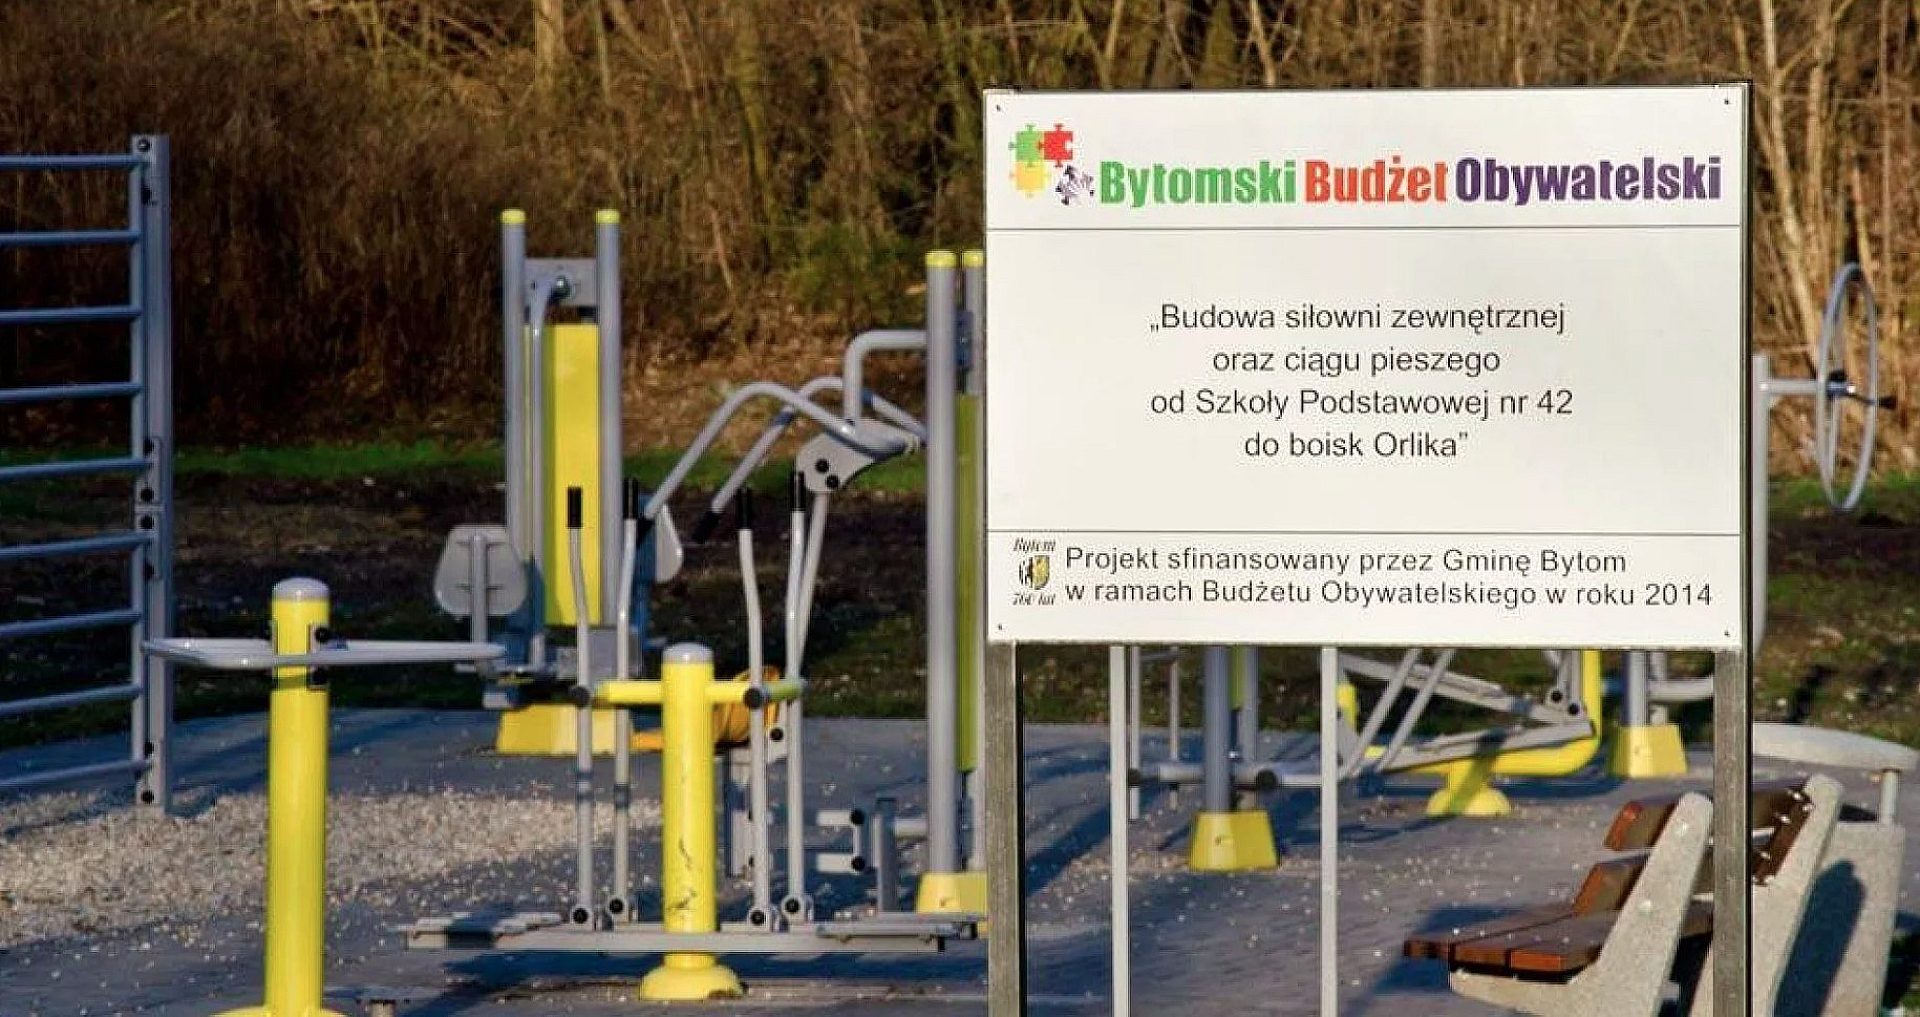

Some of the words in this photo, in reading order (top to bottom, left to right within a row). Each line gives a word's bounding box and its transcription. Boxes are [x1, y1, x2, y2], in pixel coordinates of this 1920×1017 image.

[1099, 159, 1297, 208] Bytomski
[1304, 155, 1449, 204] Budżet
[1455, 156, 1722, 206] Obywatelski
[1151, 303, 1275, 333] „Budowa
[1285, 303, 1381, 329] siłowni
[1390, 303, 1566, 336] zewnętrznej
[1213, 351, 1274, 373] oraz
[1283, 346, 1360, 379] ciągu
[1371, 346, 1501, 378] pieszego
[1150, 389, 1185, 415] od
[1196, 388, 1289, 422] Szkoły
[1300, 389, 1489, 422] Podstawowej
[1500, 394, 1529, 415] nr
[1536, 389, 1573, 415] 42
[1244, 431, 1280, 458] do
[1289, 431, 1364, 458] boisk
[1374, 431, 1468, 458] Orlika”
[1066, 547, 1159, 575] Projekt
[1167, 547, 1350, 575] sfinansowany
[1360, 554, 1433, 576] przez
[1443, 548, 1531, 577] Gminę
[1540, 549, 1626, 577] Bytom
[1064, 585, 1085, 601] w
[1094, 579, 1192, 602] ramach
[1203, 579, 1311, 603] Budżetu
[1321, 580, 1537, 610] Obywatelskiego
[1545, 587, 1567, 604] w
[1577, 583, 1634, 606] roku
[1645, 583, 1712, 606] 2014
